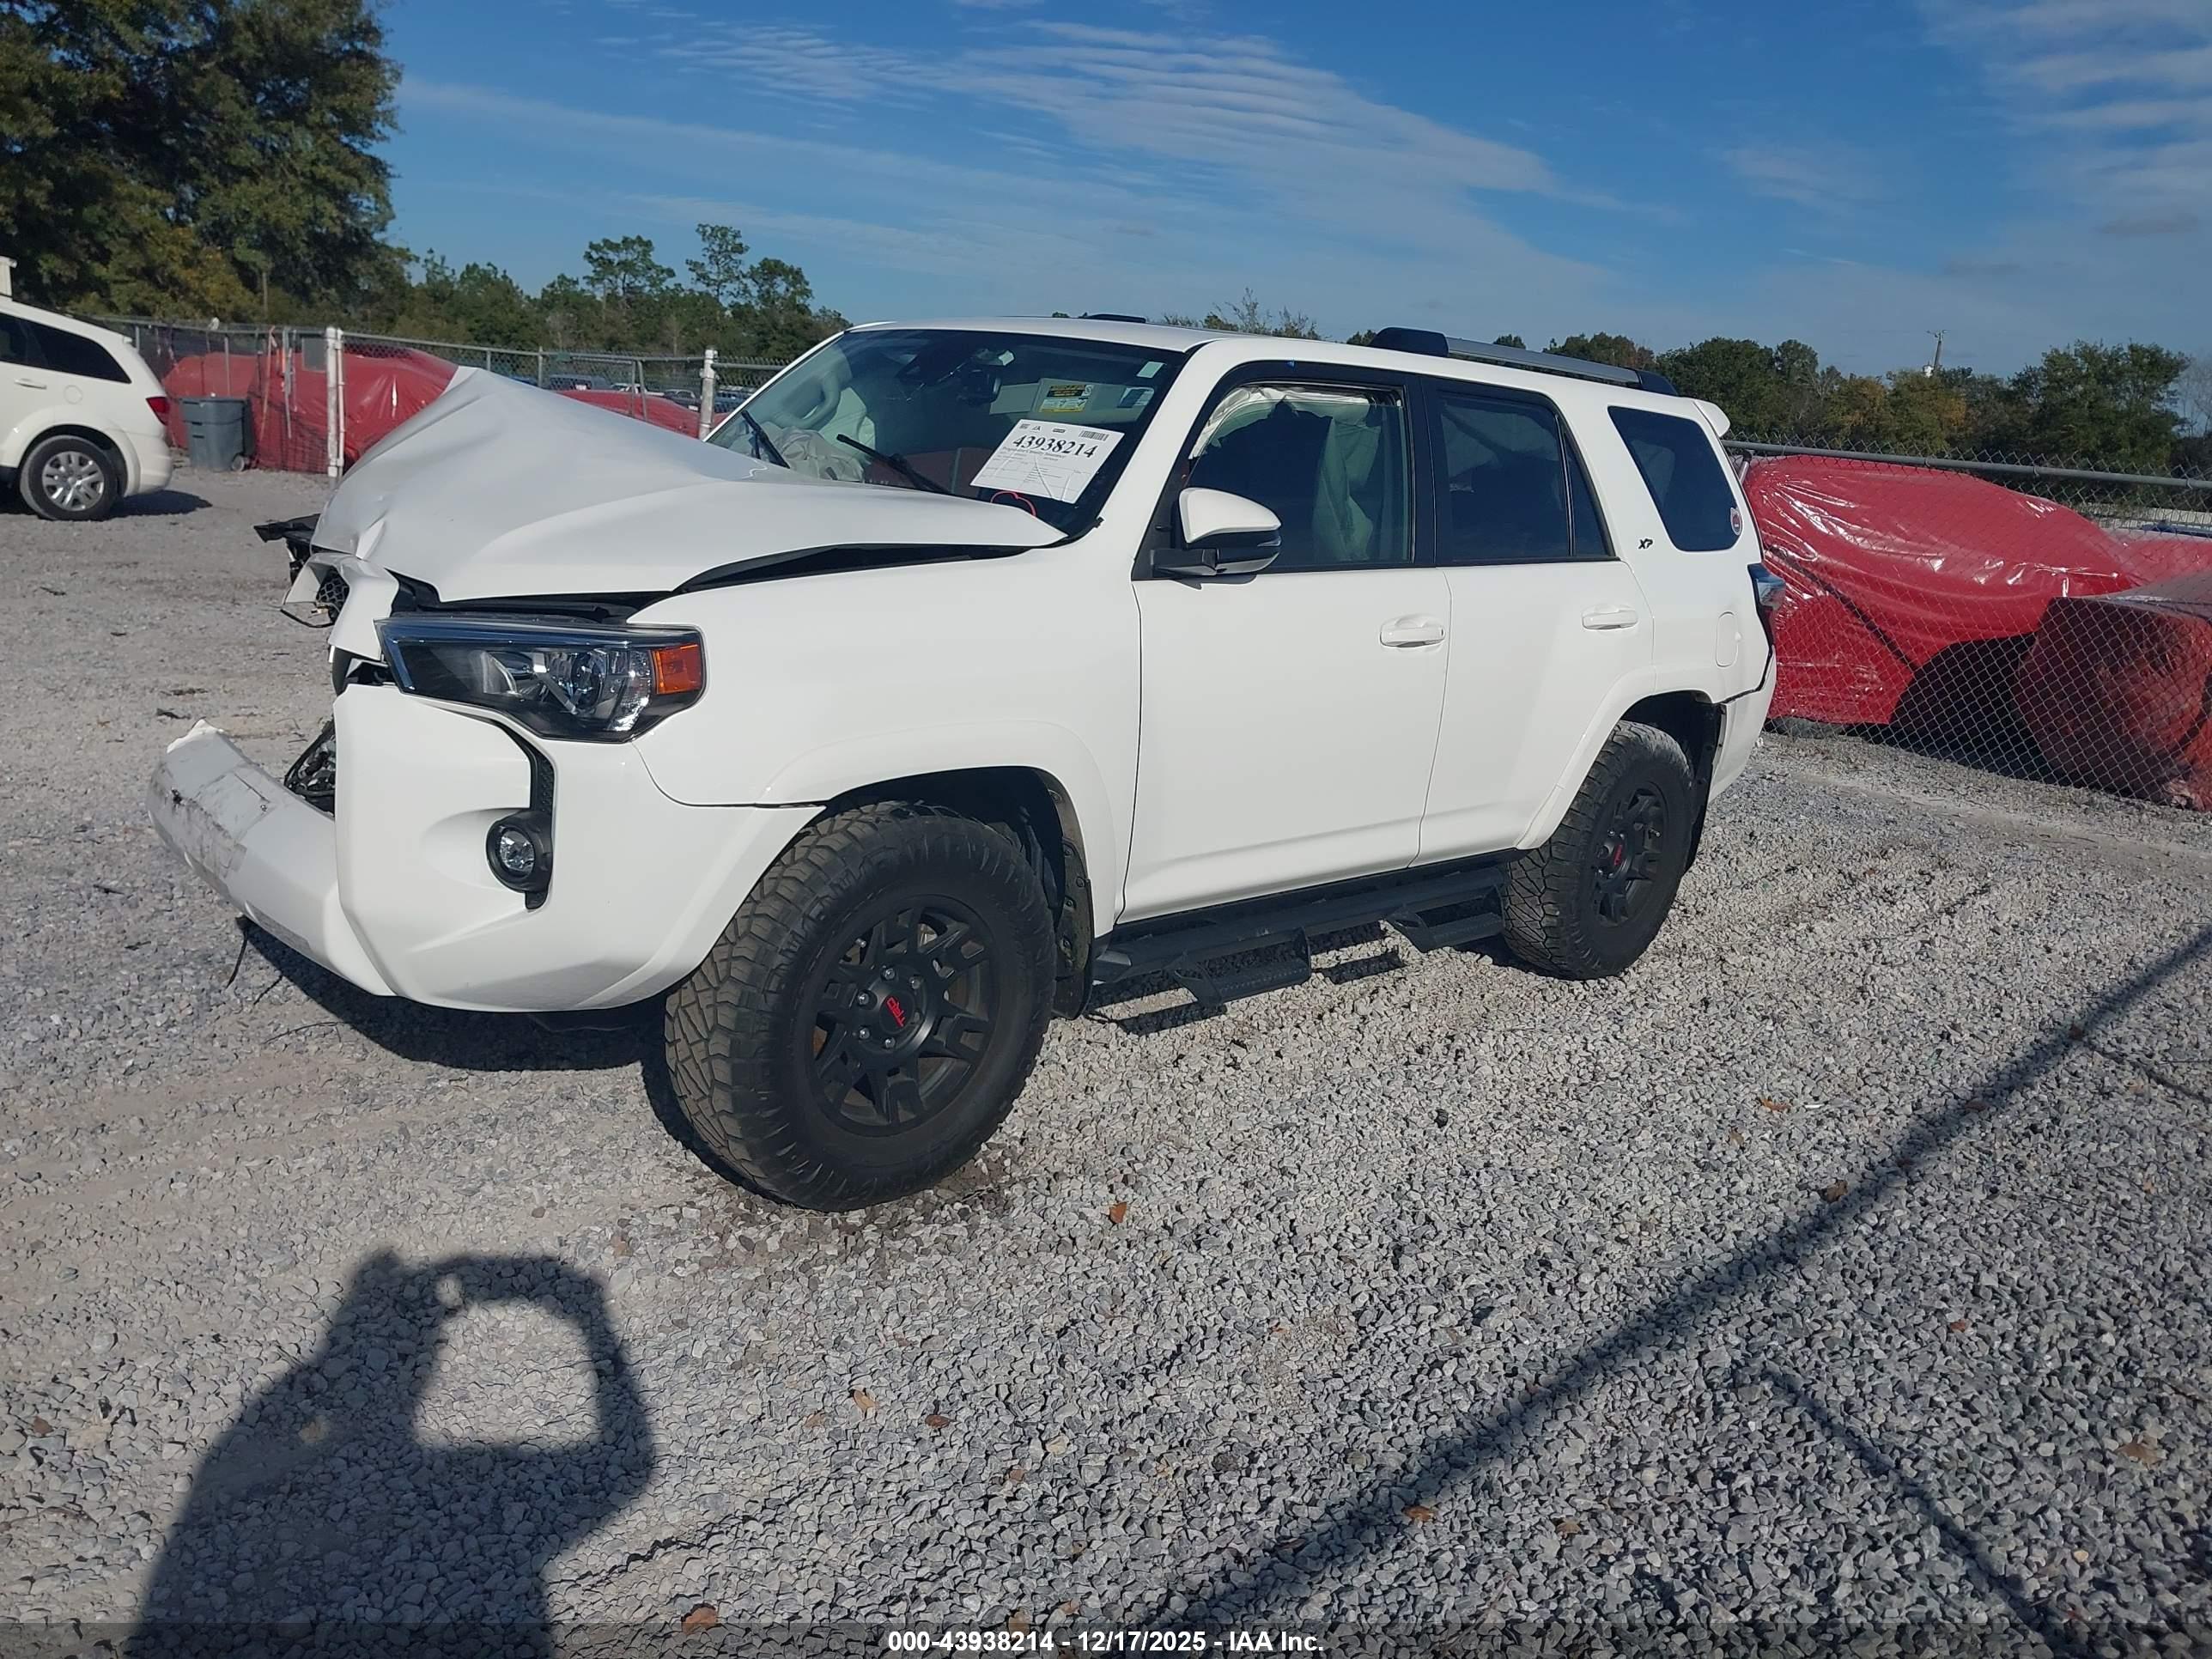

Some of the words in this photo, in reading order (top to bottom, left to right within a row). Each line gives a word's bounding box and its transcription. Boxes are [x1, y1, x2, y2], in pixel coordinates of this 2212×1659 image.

[1013, 434, 1098, 459] 43938214
[1638, 538, 1654, 550] XP
[886, 997, 906, 1027] TRD
